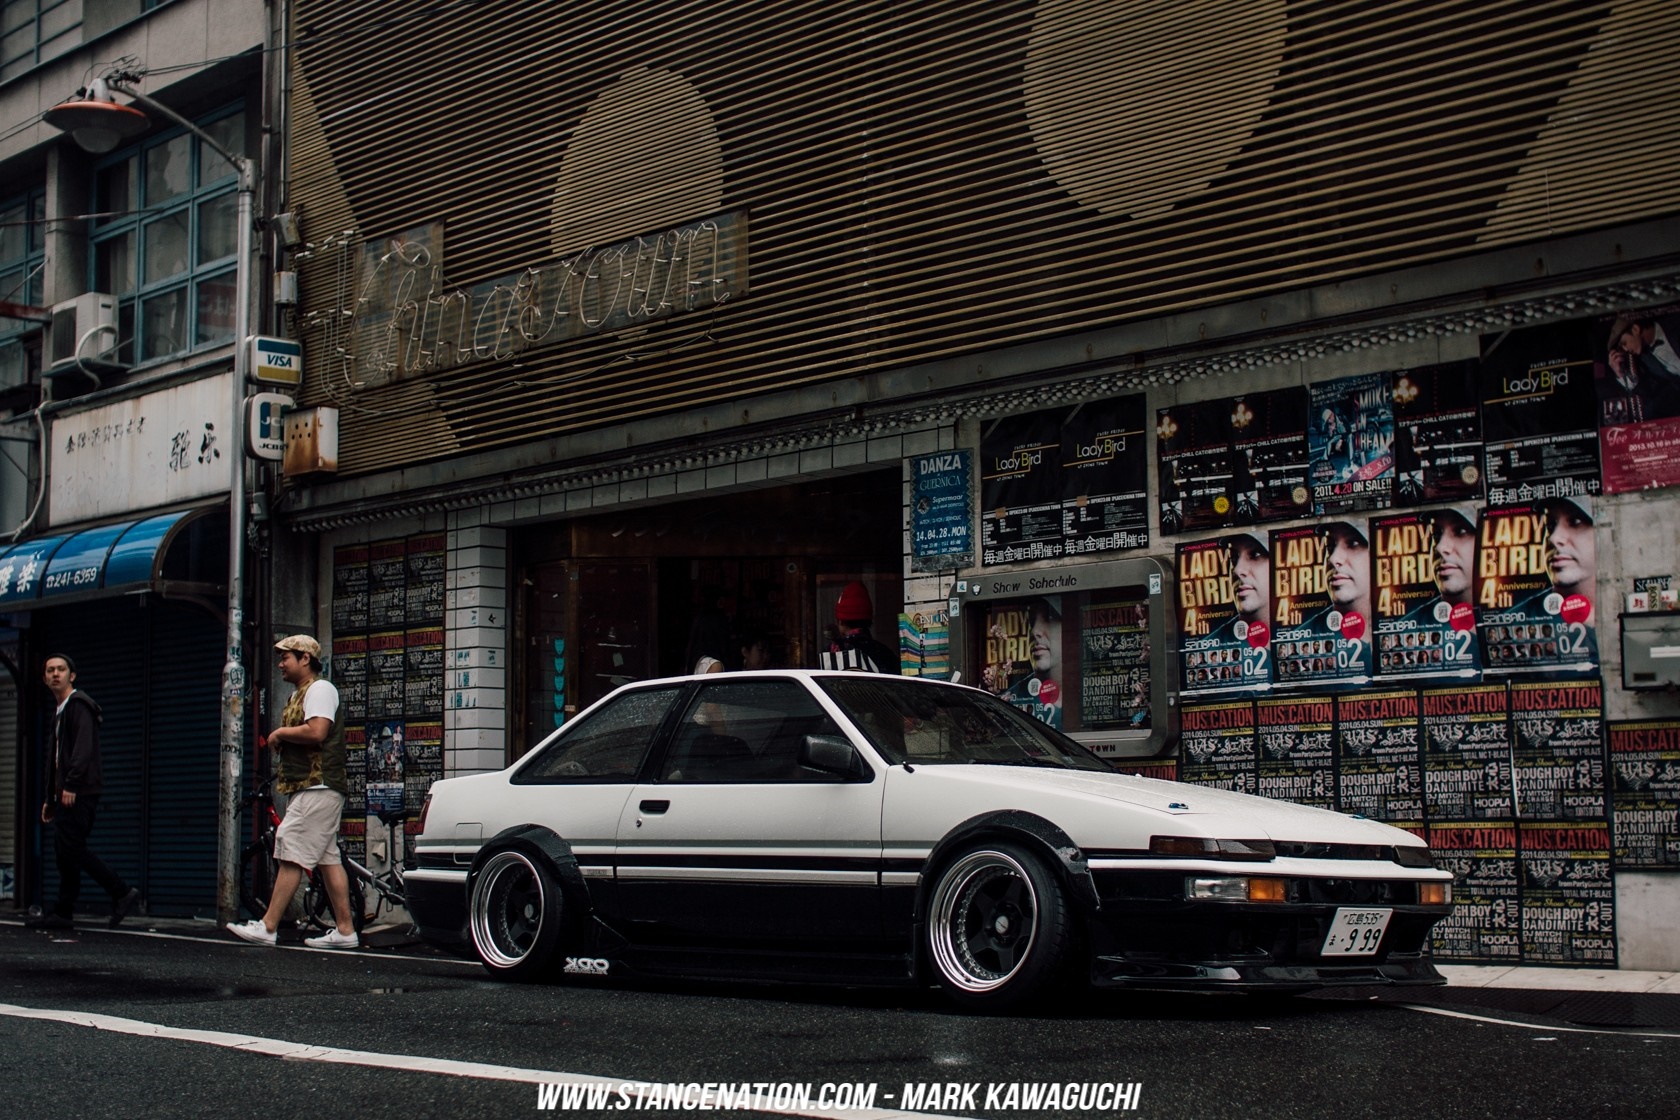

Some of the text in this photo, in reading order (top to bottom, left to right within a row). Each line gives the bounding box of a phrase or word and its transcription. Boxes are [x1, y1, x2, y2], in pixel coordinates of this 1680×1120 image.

[267, 354, 292, 368] VISA
[920, 454, 962, 475] DANZA
[919, 475, 961, 491] GUERNICA
[1313, 482, 1353, 498] 2011.4.20
[1352, 480, 1364, 493] ON
[1365, 477, 1393, 492] SALE!!
[1489, 477, 1600, 506] 毎週金曜日開催中
[916, 525, 967, 542] 14.04.28.MON
[1481, 515, 1546, 548] LADY
[1065, 531, 1148, 554] 毎週金曜日開催中
[1375, 524, 1432, 557] LADY
[984, 542, 1063, 564] 毎週金曜日開催中
[1275, 536, 1328, 569] LADY
[1179, 548, 1231, 581] LADY
[1479, 544, 1547, 579] BIRD
[1375, 553, 1434, 588] BIRD
[1275, 564, 1328, 598] BIRD
[1497, 581, 1547, 592] Anniversary
[1179, 575, 1234, 609] BIRD
[1392, 590, 1436, 600] Anniversary
[1289, 599, 1329, 611] Anniversary
[1197, 609, 1234, 620] Anniversary
[986, 610, 1029, 639] LADY
[1556, 623, 1568, 633] 05
[1444, 630, 1455, 640] 05
[1558, 621, 1590, 654] 02
[986, 637, 1030, 665] BIRD
[1337, 638, 1347, 649] 05
[1444, 629, 1473, 661] 02
[1243, 648, 1253, 657] 05
[1338, 638, 1365, 669] 02
[1243, 646, 1268, 676] 02
[1089, 744, 1116, 753] TOWN
[1340, 771, 1396, 788] DOUGH BOY
[1426, 768, 1485, 784] DOUGH BOY
[1514, 765, 1576, 781] DOUGH BOY
[1215, 778, 1233, 791] BOY
[1260, 775, 1312, 790] DOUGH BOY
[1426, 780, 1485, 794] DANDIMITE
[1514, 778, 1576, 792] DANDIMITE
[1260, 787, 1312, 800] DANDIMITE
[1340, 783, 1396, 798] DANDIMITE
[1438, 792, 1464, 800] MITCH
[1352, 795, 1376, 803] MITCH
[1385, 798, 1422, 811] HOOPLA
[1473, 796, 1512, 809] HOOPLA
[1563, 795, 1605, 807] HOOPLA
[1614, 809, 1678, 824] DOUGH BOY
[1614, 822, 1678, 836] DANDIMITE
[1470, 905, 1492, 917] BOY
[1522, 907, 1585, 920] DOUGH BOY
[1522, 920, 1585, 931] DANDIMITE
[1480, 935, 1520, 945] HOOPLA
[1572, 939, 1614, 949] HOOPLA
